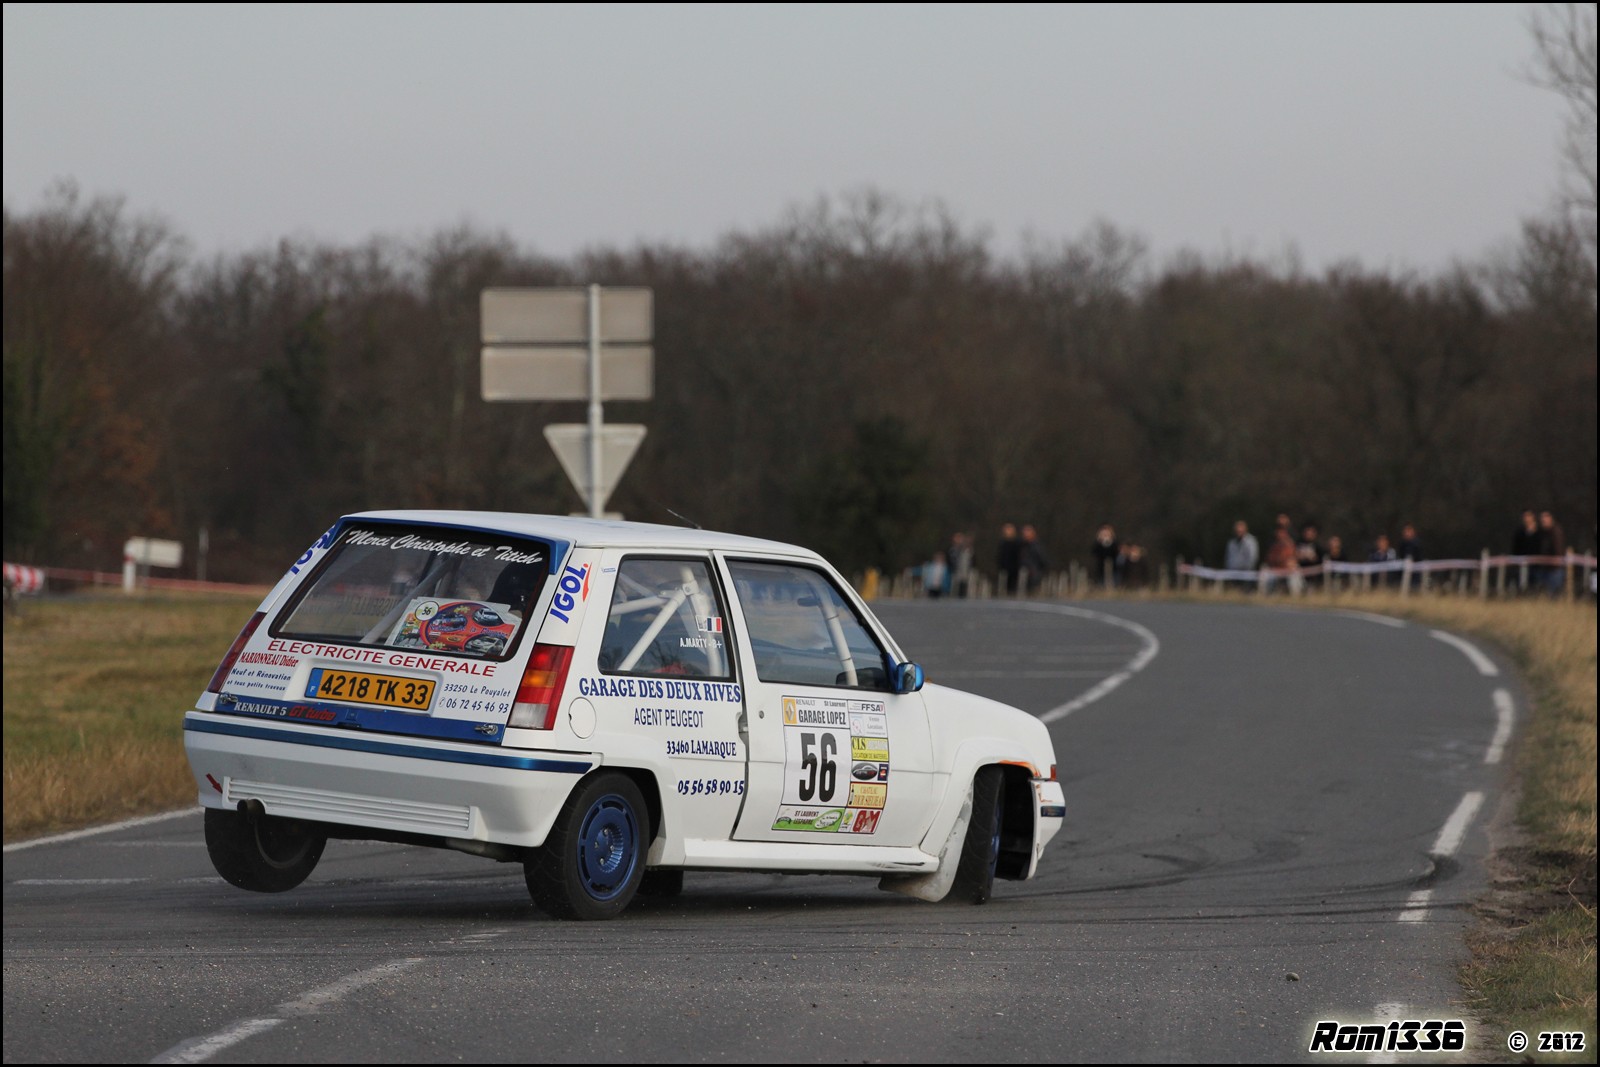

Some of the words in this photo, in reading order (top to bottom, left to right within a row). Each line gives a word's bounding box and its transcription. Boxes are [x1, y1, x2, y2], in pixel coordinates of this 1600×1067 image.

[346, 530, 394, 546] Merci
[390, 534, 472, 556] Christophe
[471, 546, 491, 557] et
[549, 563, 587, 624] IGOL
[421, 606, 433, 616] 56
[240, 652, 280, 666] MARIONNEAU
[279, 655, 299, 668] Didier
[267, 640, 386, 664] ELECTRICITE
[388, 654, 497, 677] GENERALE
[231, 667, 248, 676] Neuf
[320, 674, 370, 698] 4218
[375, 679, 399, 702] TK
[401, 683, 429, 705] 33
[443, 683, 468, 693] 33250
[469, 685, 478, 694] Le
[480, 686, 511, 698] Pouyalet
[579, 677, 636, 697] GARAGE
[638, 680, 664, 698] DES
[666, 682, 702, 701] DEUX
[703, 683, 741, 703] RIVES
[234, 702, 280, 715] RENAULT
[279, 707, 287, 716] 5
[289, 705, 306, 718] GT
[305, 707, 336, 721] turbo
[446, 698, 457, 709] 06
[459, 700, 469, 710] 72
[471, 701, 482, 711] 45
[484, 701, 495, 712] 46
[498, 703, 509, 714] 93
[861, 703, 881, 712] FFSA
[634, 707, 662, 726] AGENT
[665, 710, 704, 728] PEUGEOT
[798, 709, 826, 724] GARAGE
[826, 711, 846, 725] LOPEZ
[666, 741, 690, 755] 33460
[691, 740, 736, 759] LAMARQUE
[799, 732, 837, 802] 56
[677, 780, 689, 795] 05
[691, 779, 703, 795] 56
[705, 779, 718, 795] 58
[719, 780, 731, 795] 90
[733, 780, 744, 795] 15
